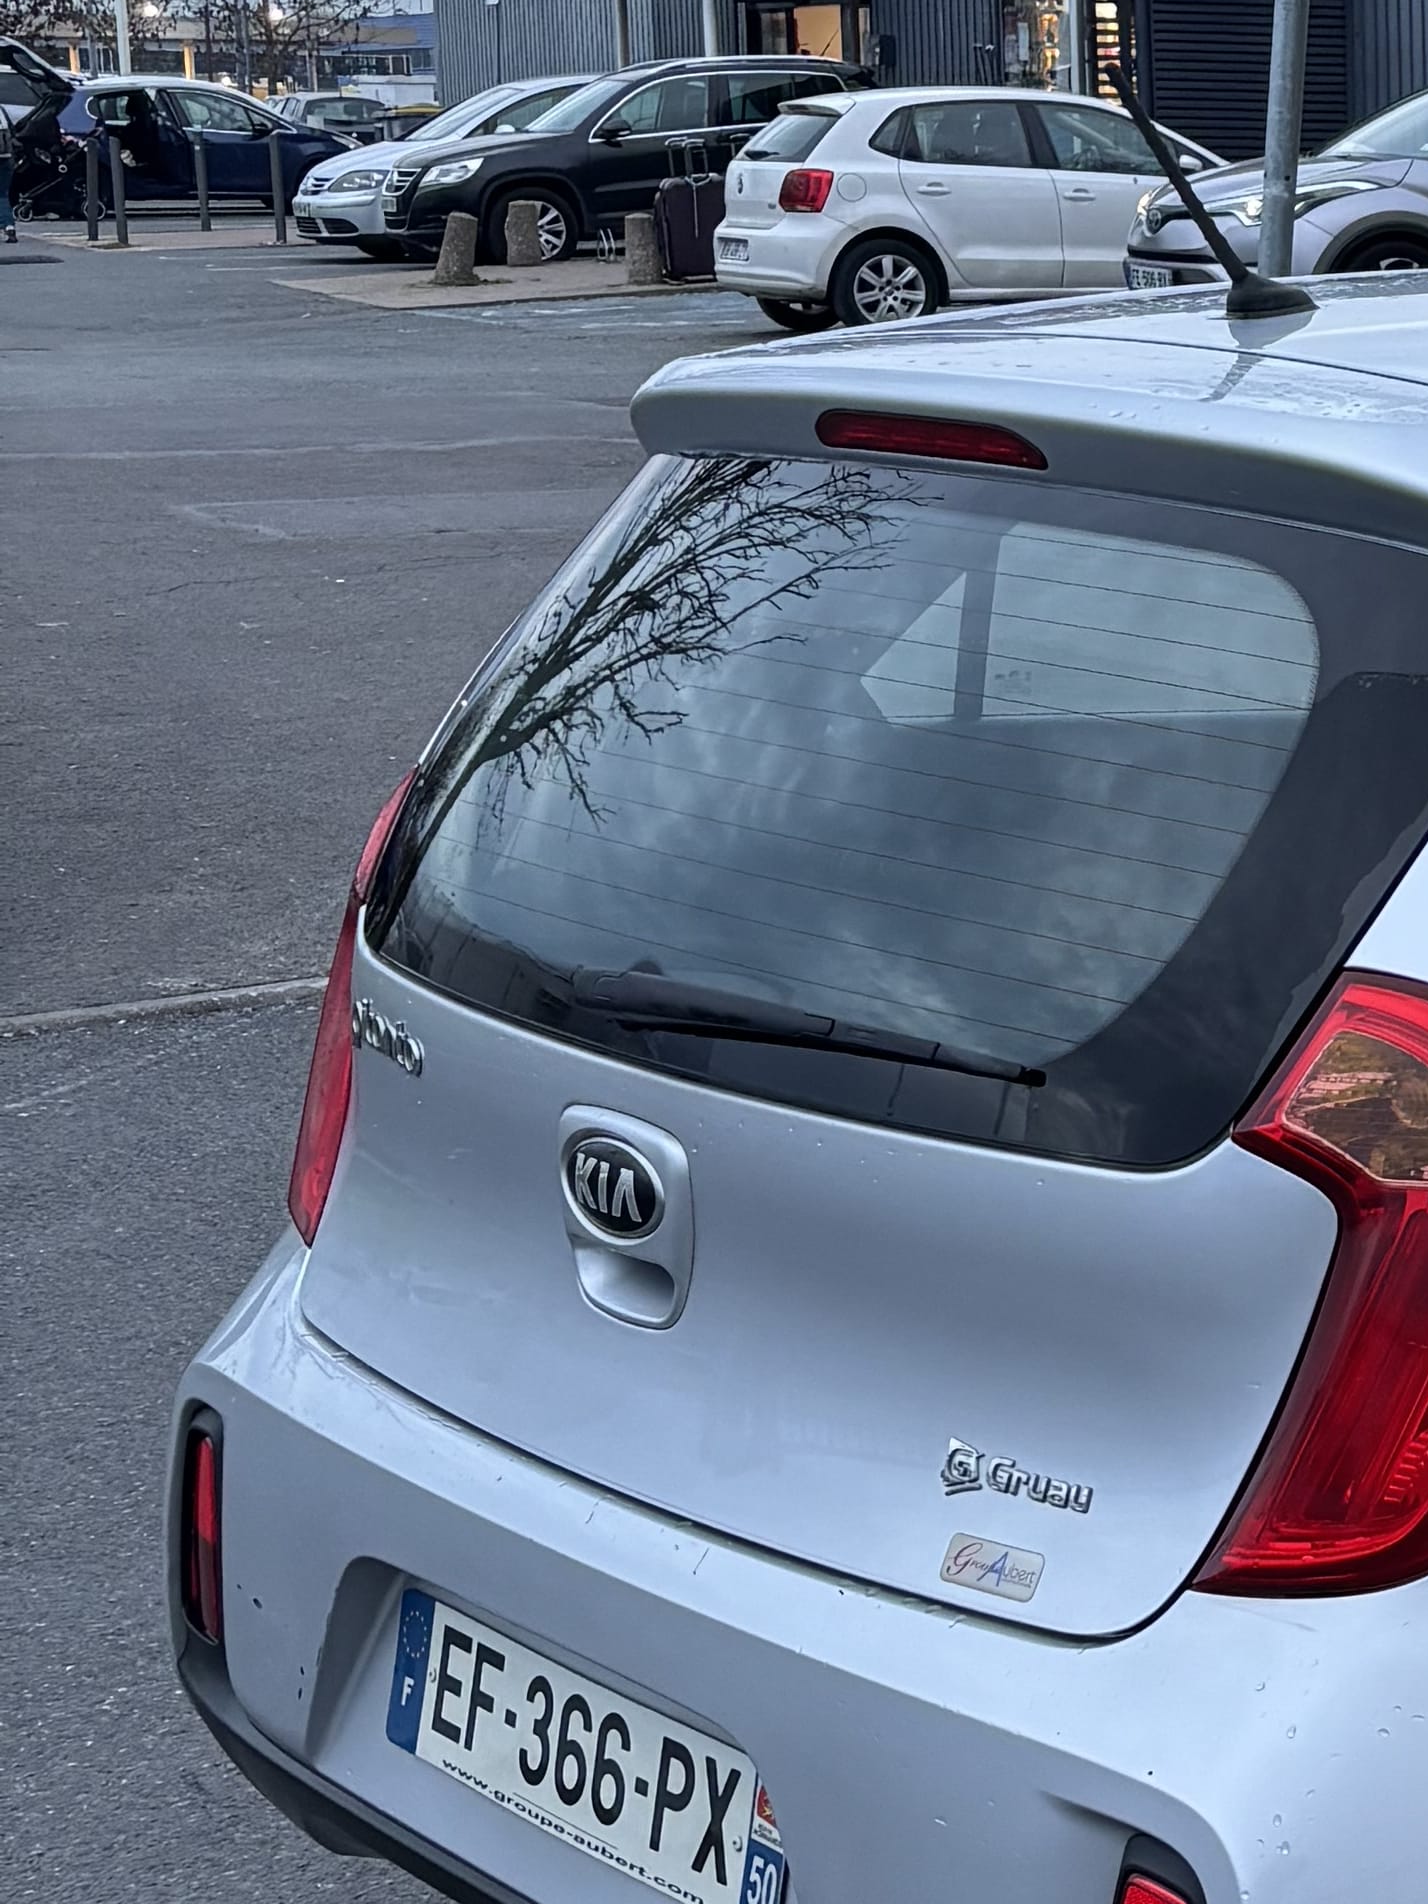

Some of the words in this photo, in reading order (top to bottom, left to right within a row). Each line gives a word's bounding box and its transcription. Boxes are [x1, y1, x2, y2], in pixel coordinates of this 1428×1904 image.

[574, 1152, 643, 1223] KIA
[401, 1676, 415, 1707] F
[431, 1624, 742, 1886] EF-366-PX
